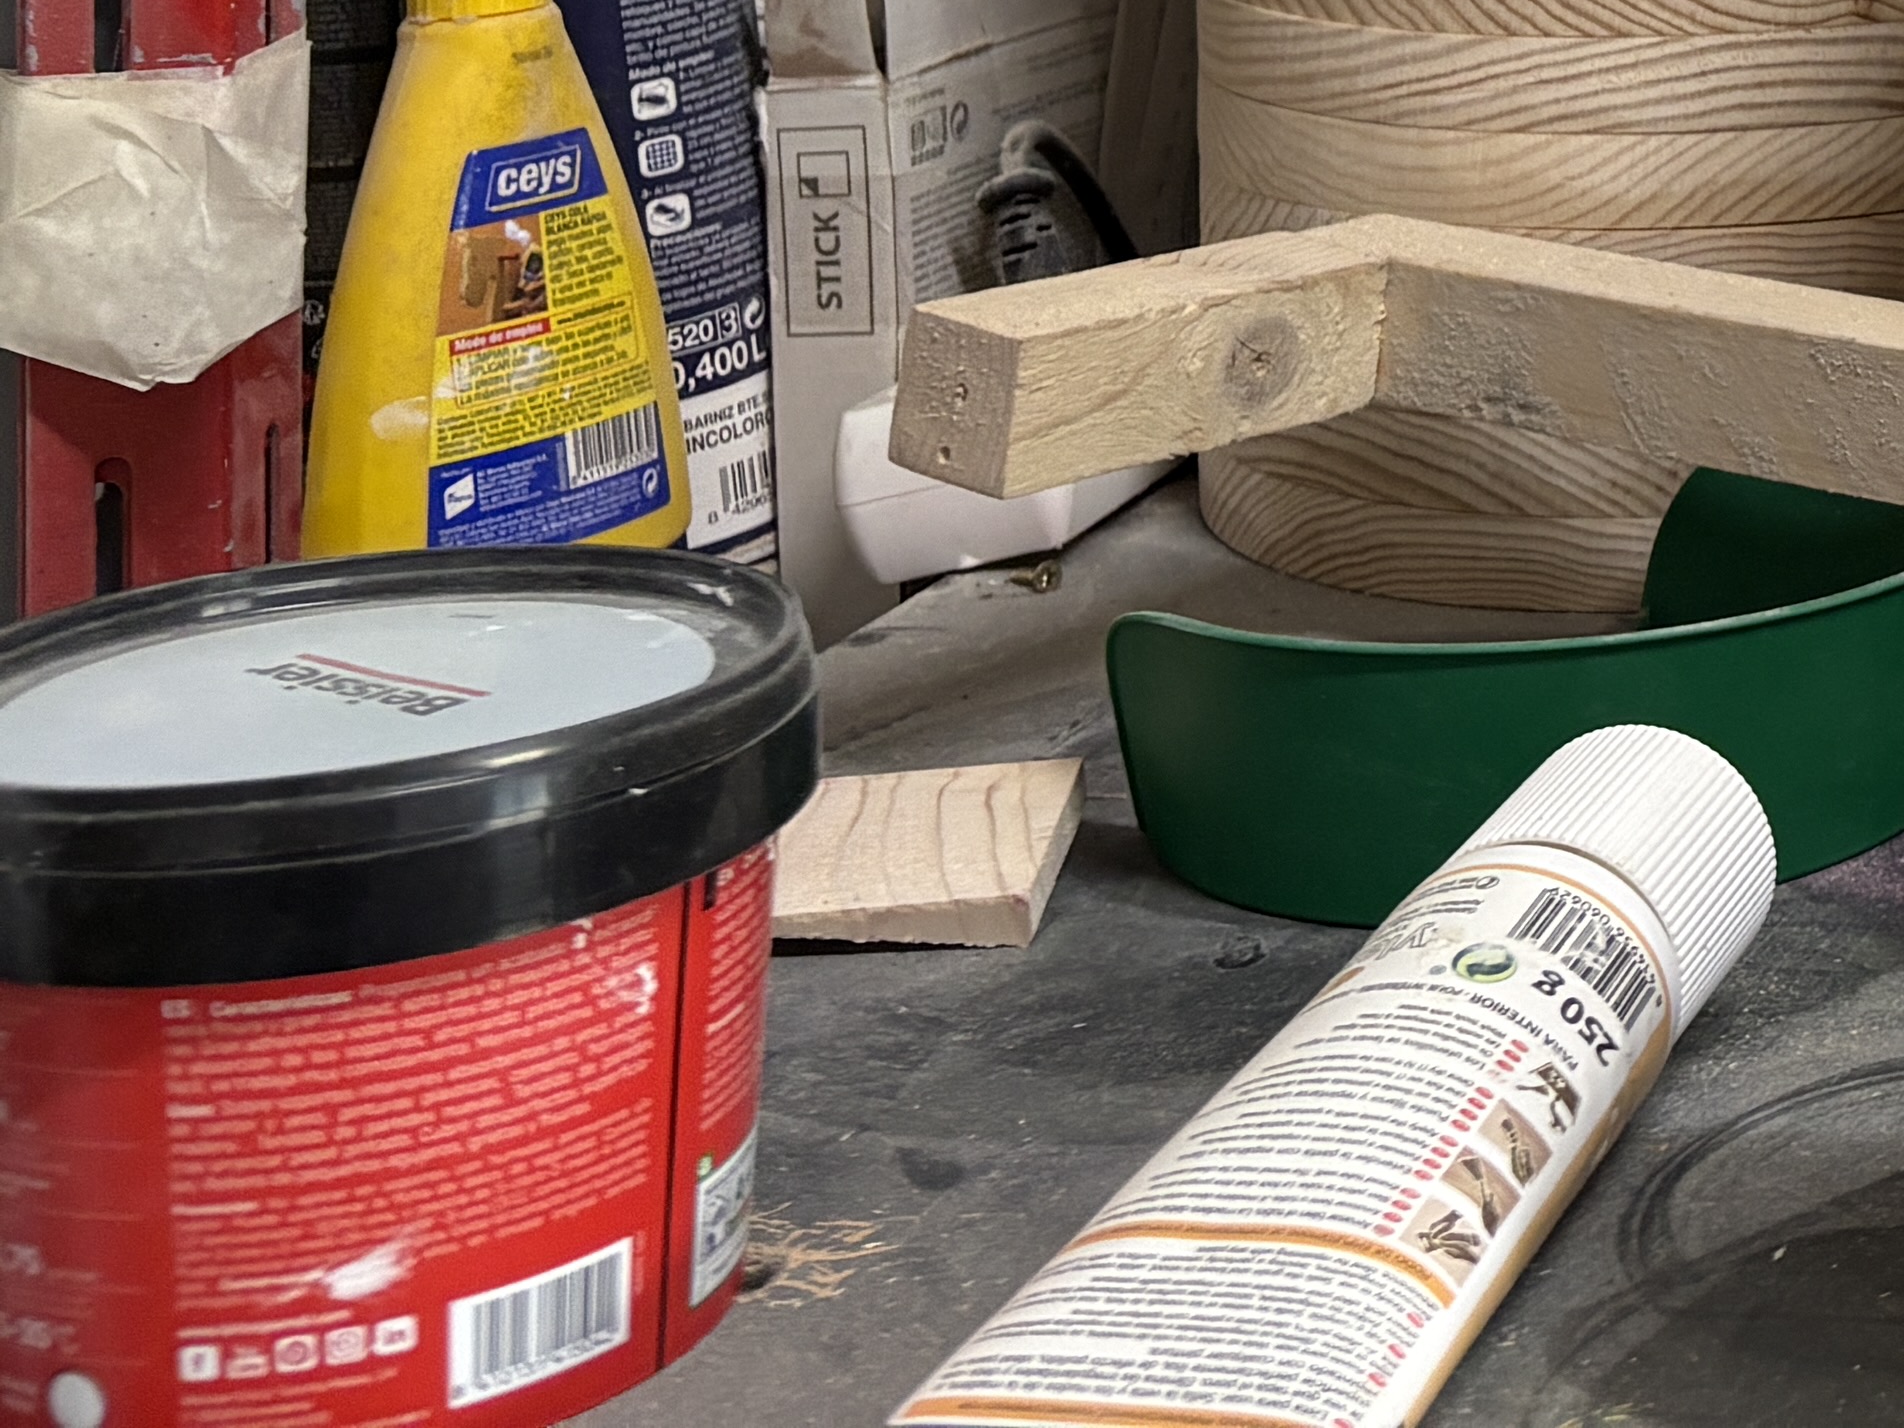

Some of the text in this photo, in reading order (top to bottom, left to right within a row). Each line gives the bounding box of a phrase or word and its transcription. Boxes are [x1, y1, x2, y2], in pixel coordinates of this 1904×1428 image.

[497, 155, 572, 197] ceys
[813, 210, 843, 311] STICK
[454, 334, 487, 352] Modo
[489, 330, 503, 343] de
[667, 308, 739, 350] 520 3
[752, 333, 767, 363] L
[684, 403, 735, 433] BARNIZ
[245, 662, 471, 716] Beissier
[1469, 993, 1541, 1036] INTERIOR
[1530, 969, 1620, 1067] 250 g
[1543, 1035, 1580, 1071] PARA
